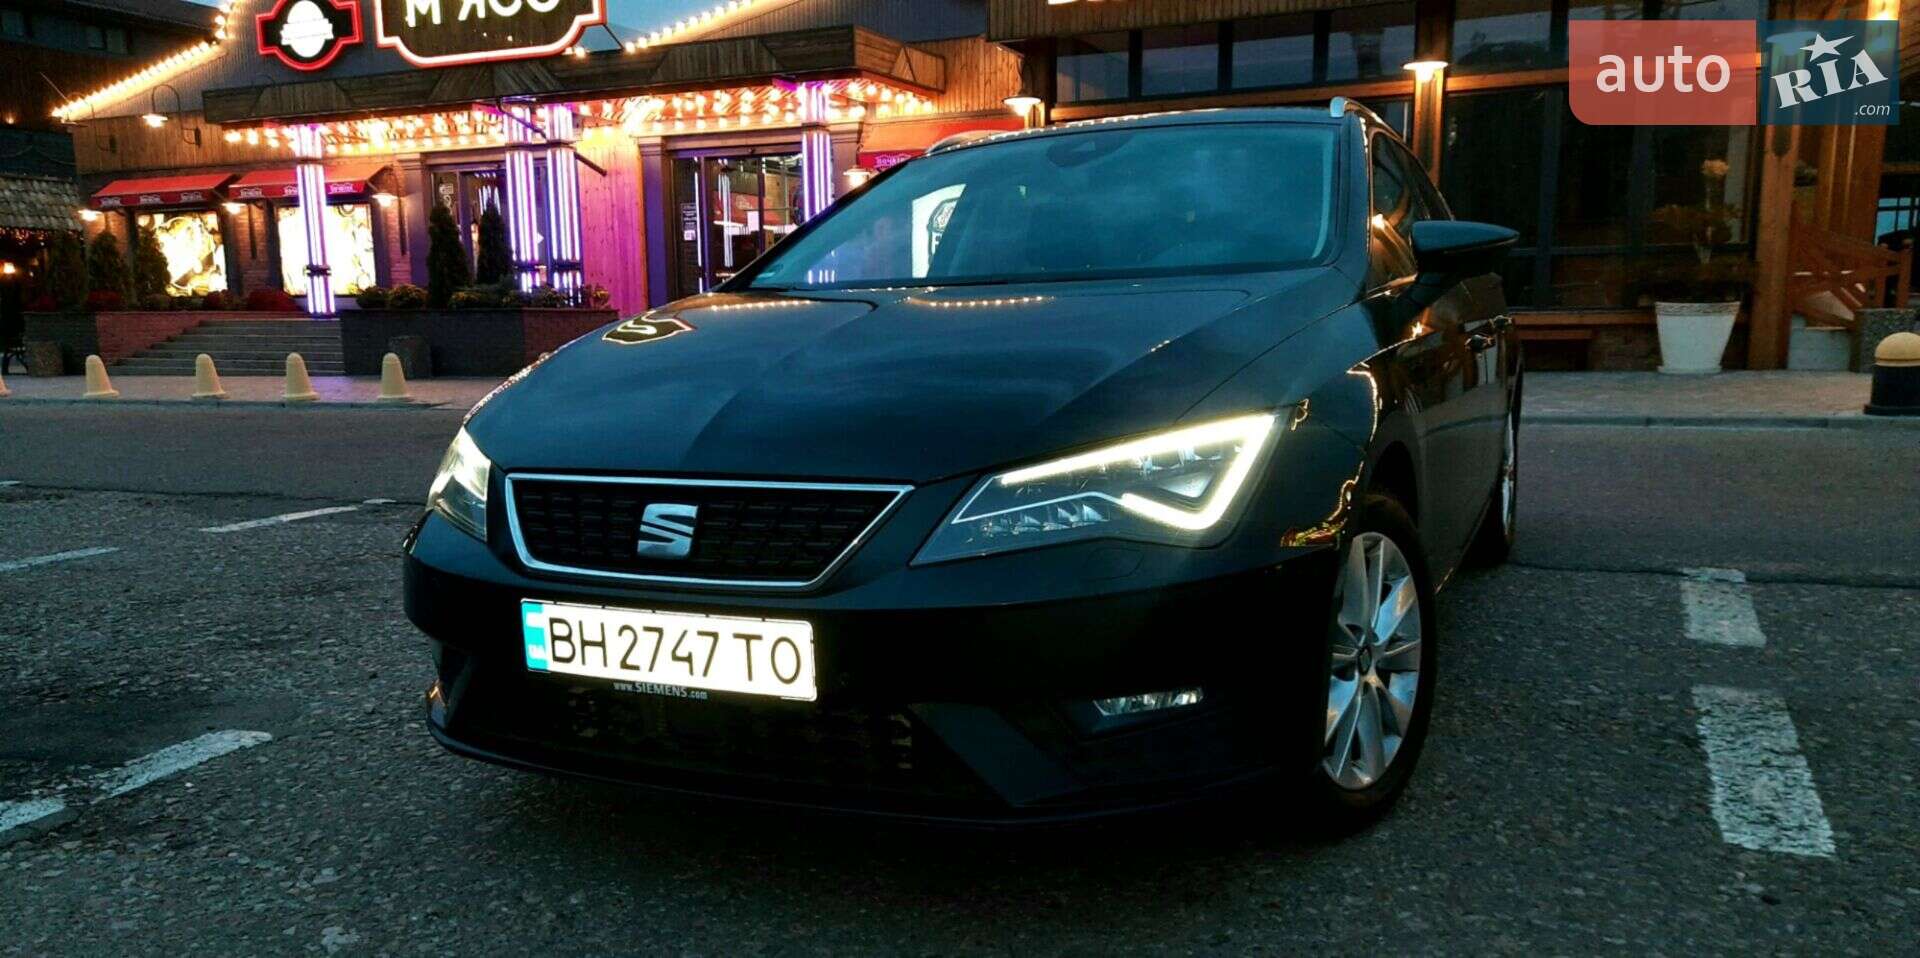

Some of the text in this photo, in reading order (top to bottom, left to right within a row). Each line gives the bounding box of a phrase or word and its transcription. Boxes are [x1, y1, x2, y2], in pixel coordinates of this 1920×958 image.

[549, 617, 802, 685] BH 2747 TO
[613, 682, 708, 700] www.SIEMENS.com
